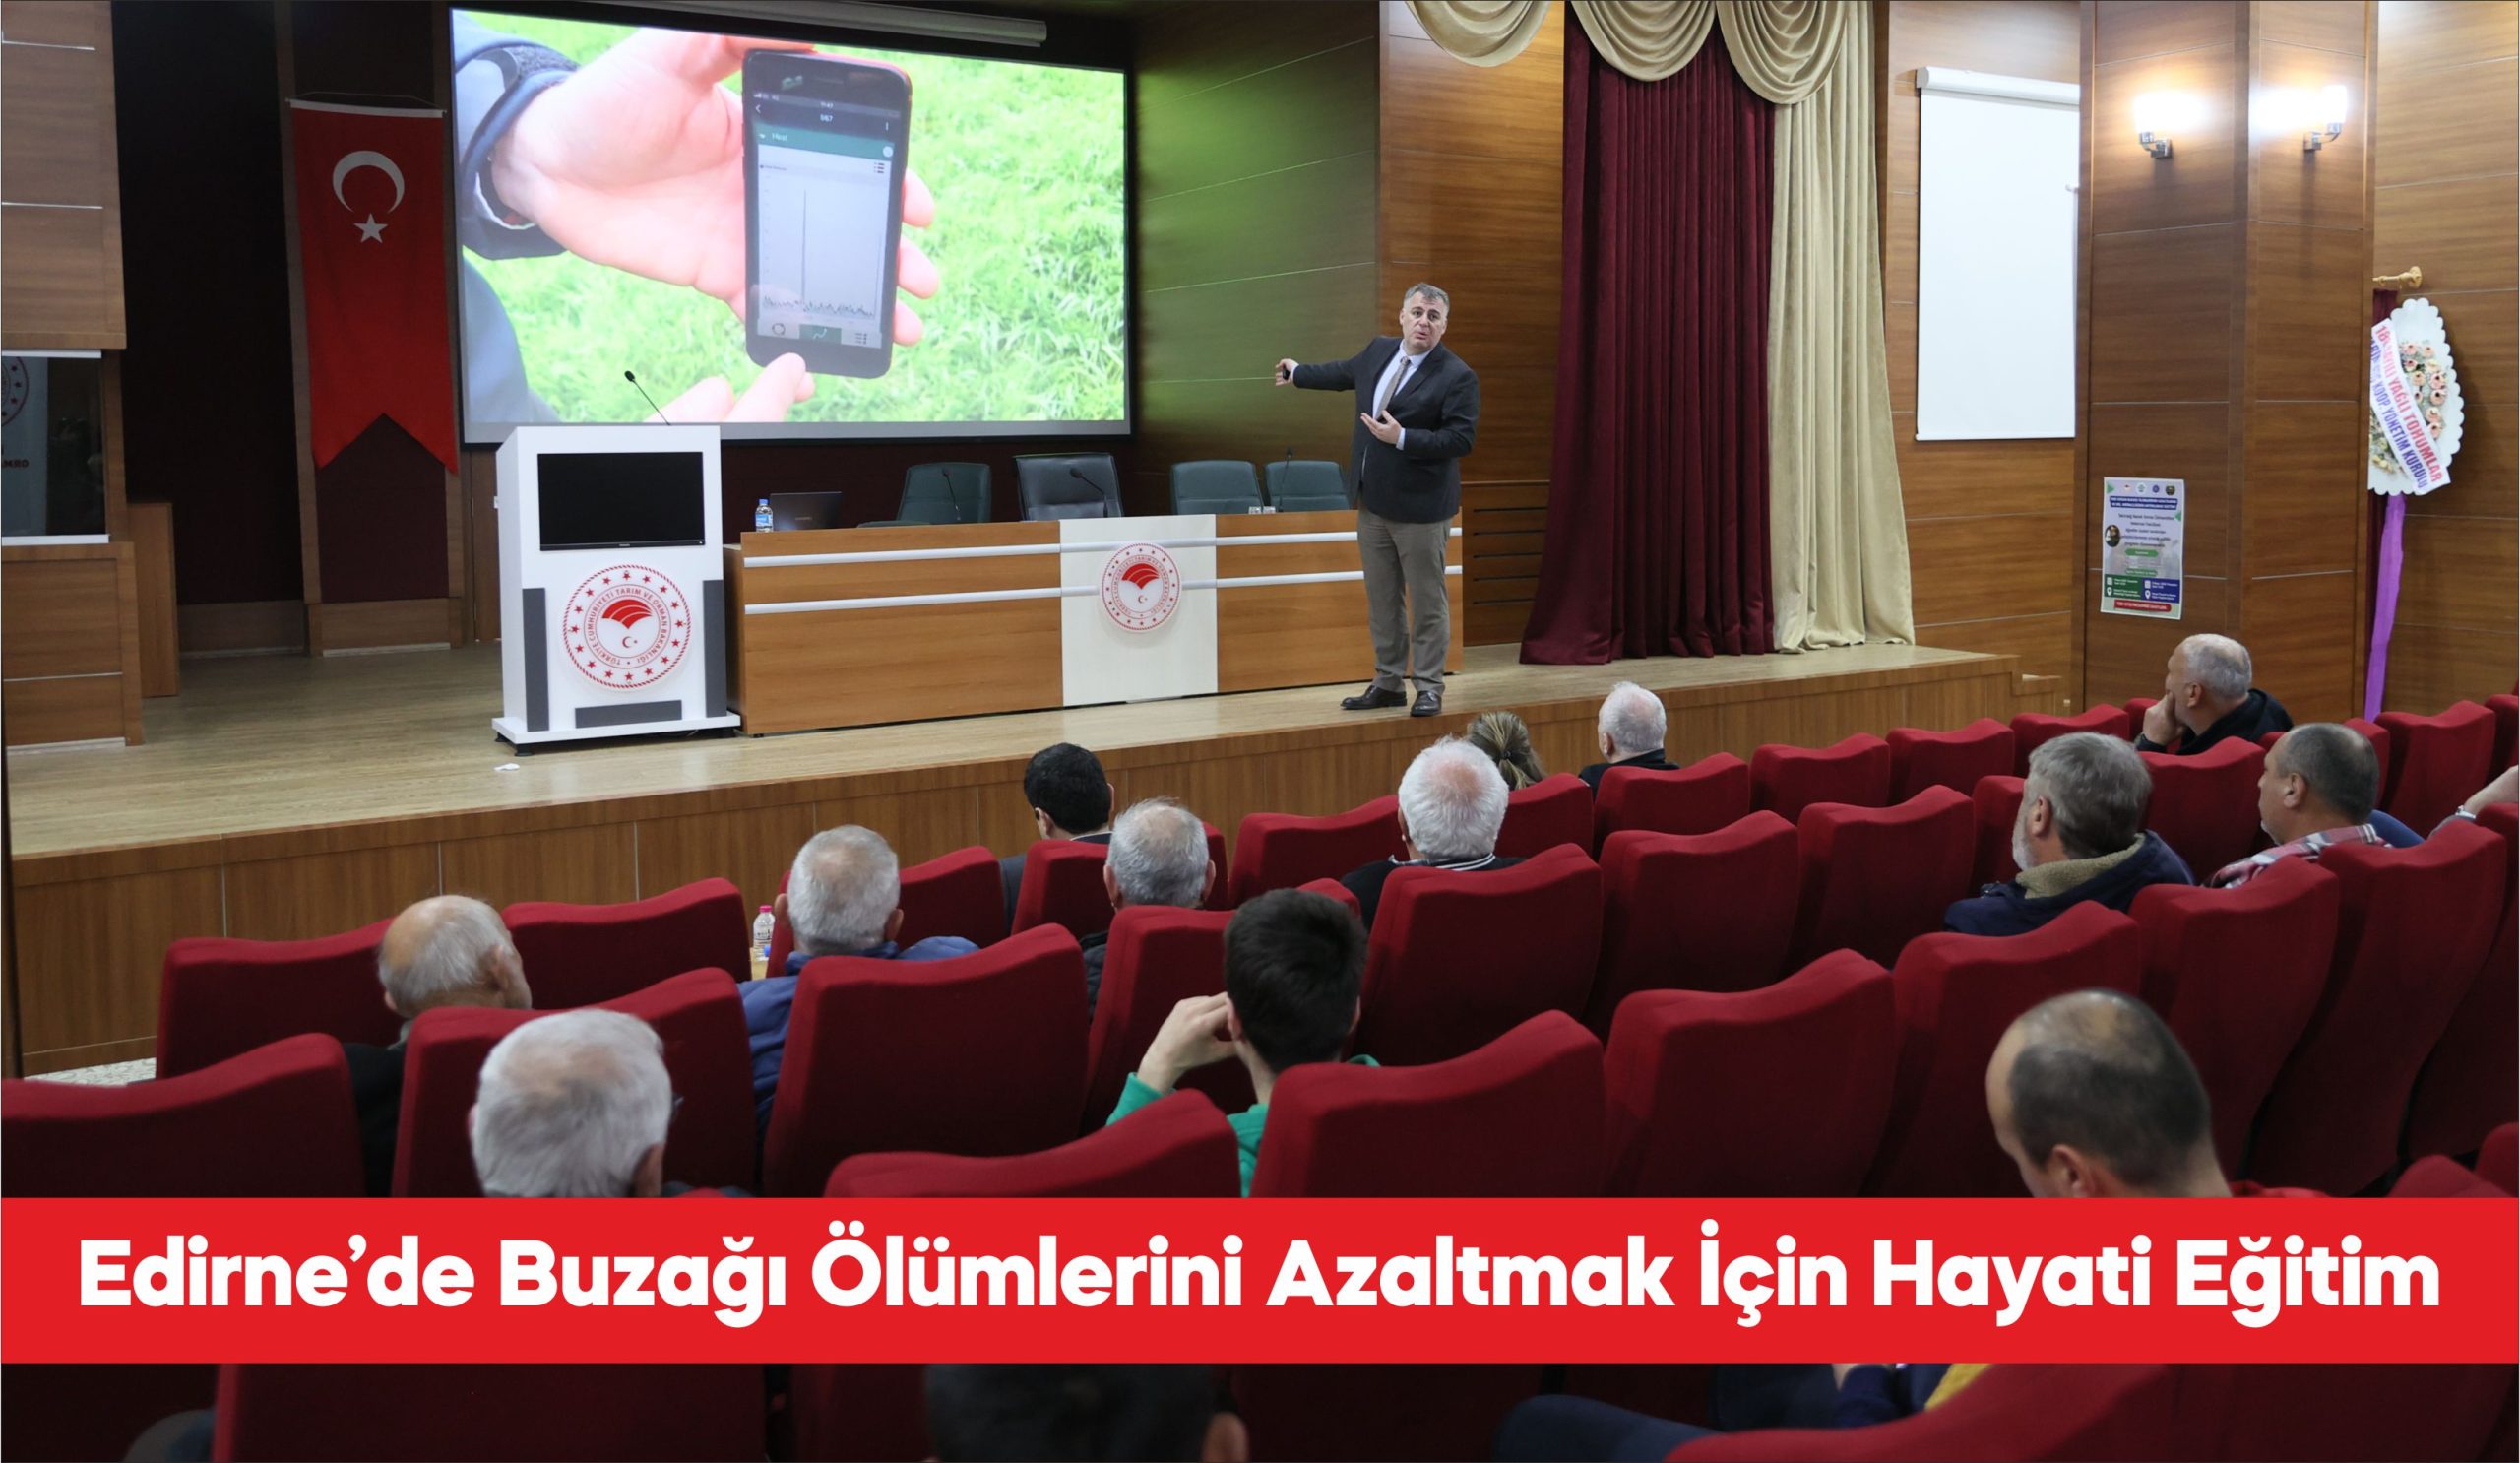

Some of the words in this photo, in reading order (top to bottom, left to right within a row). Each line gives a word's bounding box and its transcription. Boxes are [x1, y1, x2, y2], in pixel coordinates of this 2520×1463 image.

[2382, 407, 2411, 451] YÖNETİM
[2402, 449, 2428, 488] KURULU
[2403, 412, 2443, 482] TOHUMLAR
[643, 592, 653, 601] VE
[653, 599, 667, 626] ORMAN
[588, 592, 614, 642] CUMHURİYETİ
[592, 642, 621, 666] TÜRKİYE
[637, 628, 667, 664] BAKANLIĞI
